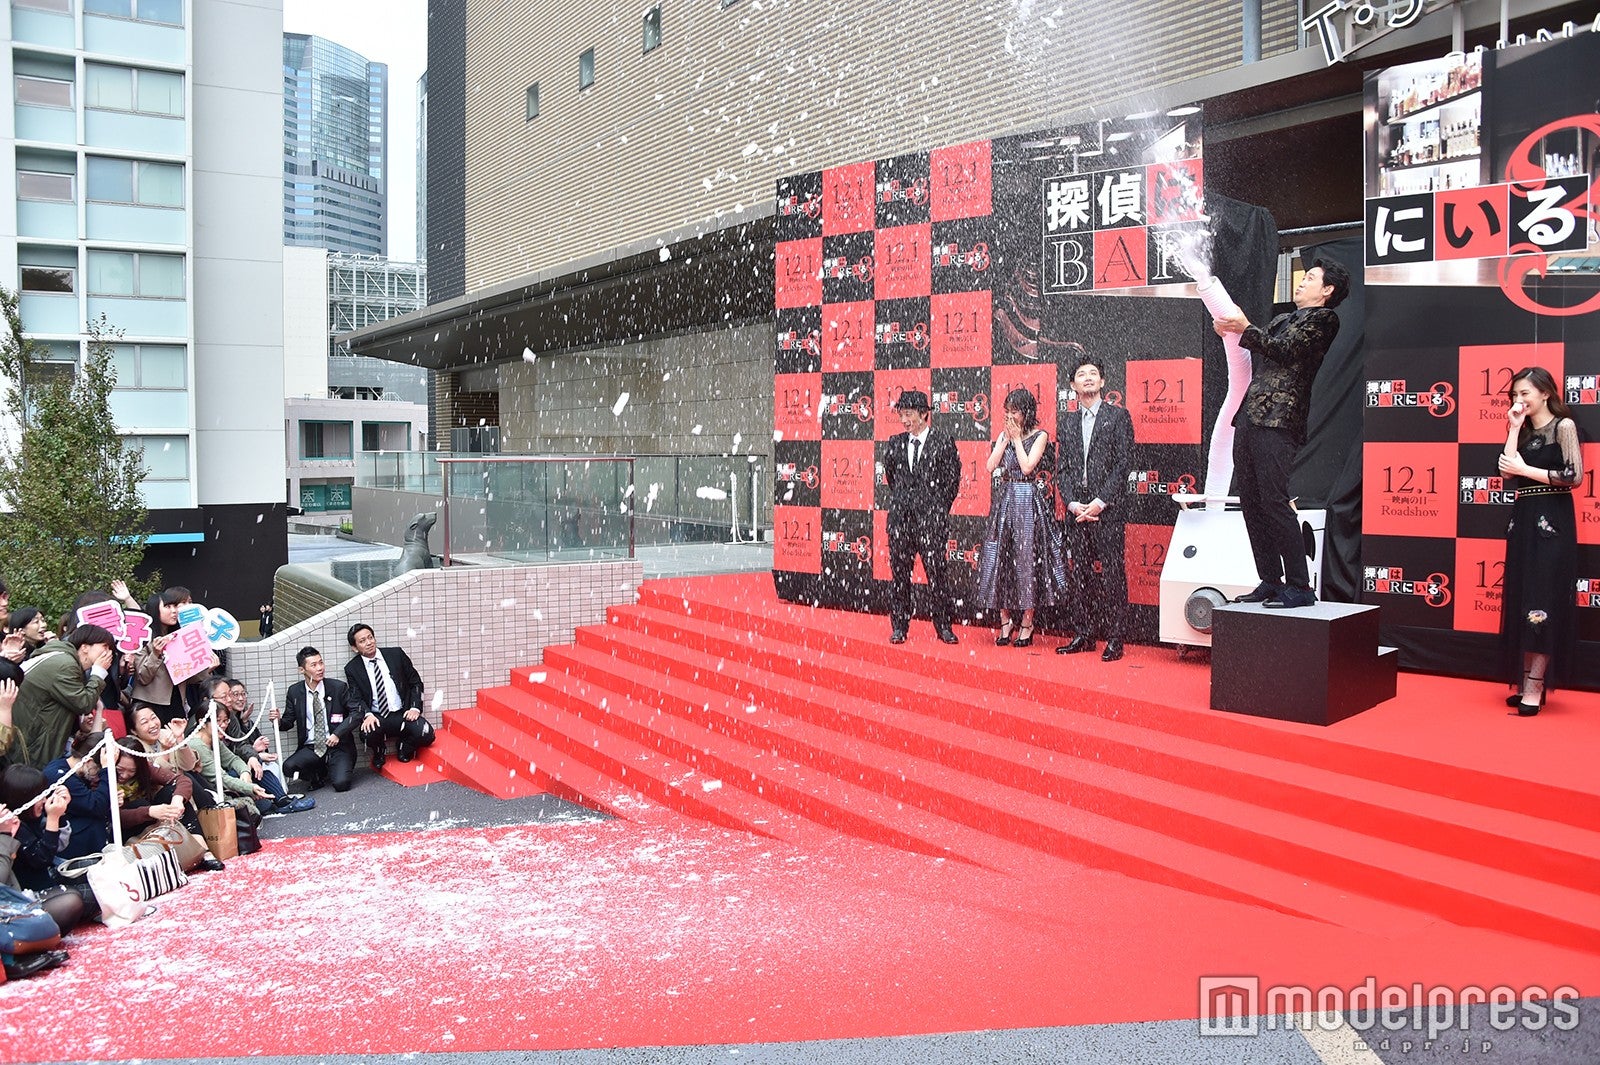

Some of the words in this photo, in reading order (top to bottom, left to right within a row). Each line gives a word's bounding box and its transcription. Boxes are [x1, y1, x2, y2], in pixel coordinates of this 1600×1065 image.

[1374, 185, 1576, 257] にいる
[943, 311, 979, 334] 12.1
[1142, 379, 1186, 404] 12.1
[1481, 367, 1514, 396] 12
[1567, 376, 1600, 390] 探偵
[1383, 466, 1438, 494] 12.1
[1463, 491, 1515, 503] BARに
[1382, 505, 1439, 517] Roadshow
[783, 521, 812, 541] 12.1
[1140, 543, 1165, 567] 12
[1476, 561, 1506, 588] 12
